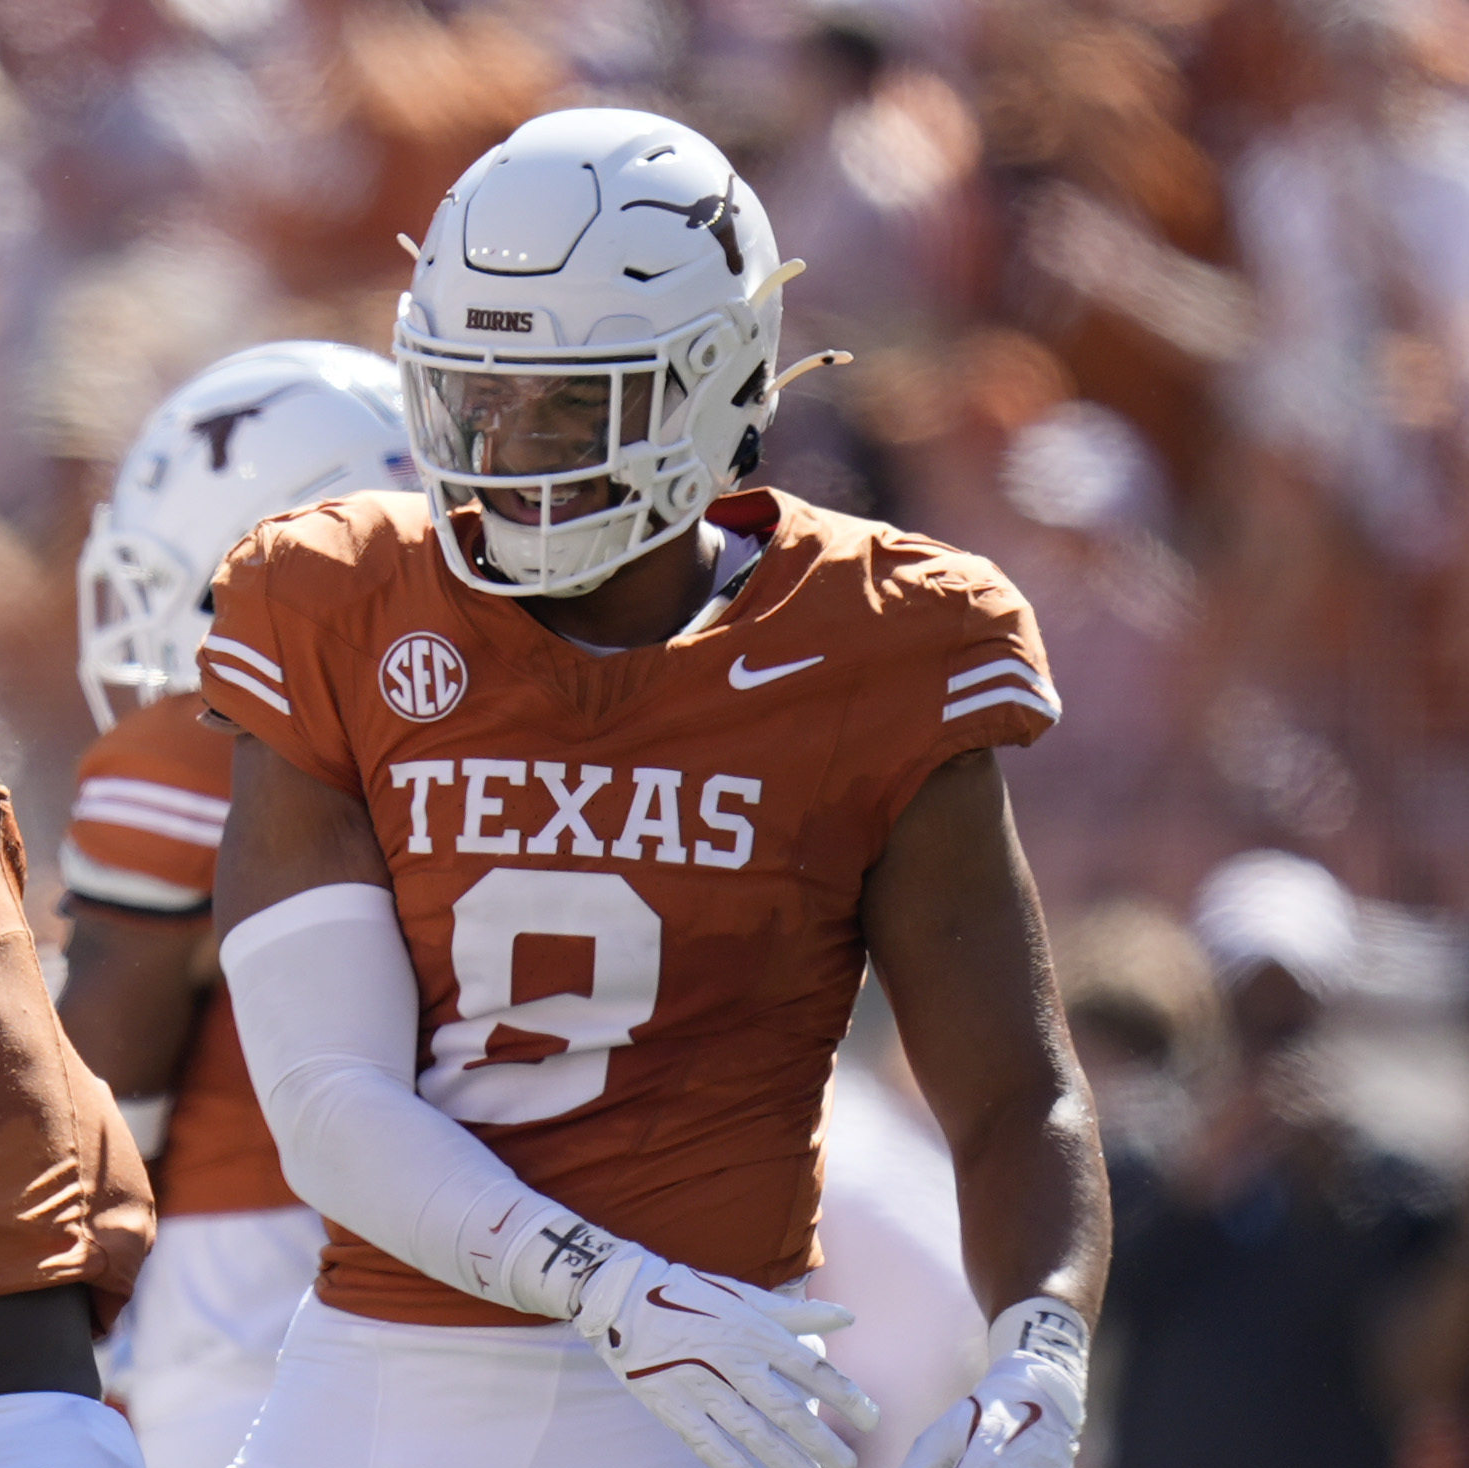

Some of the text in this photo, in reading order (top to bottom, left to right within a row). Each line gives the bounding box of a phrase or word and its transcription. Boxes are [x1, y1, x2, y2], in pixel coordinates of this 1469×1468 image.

[466, 308, 534, 332] HORNS
[384, 638, 459, 714] SEC
[389, 758, 761, 869] TEXAS
[417, 867, 662, 1124] 8
